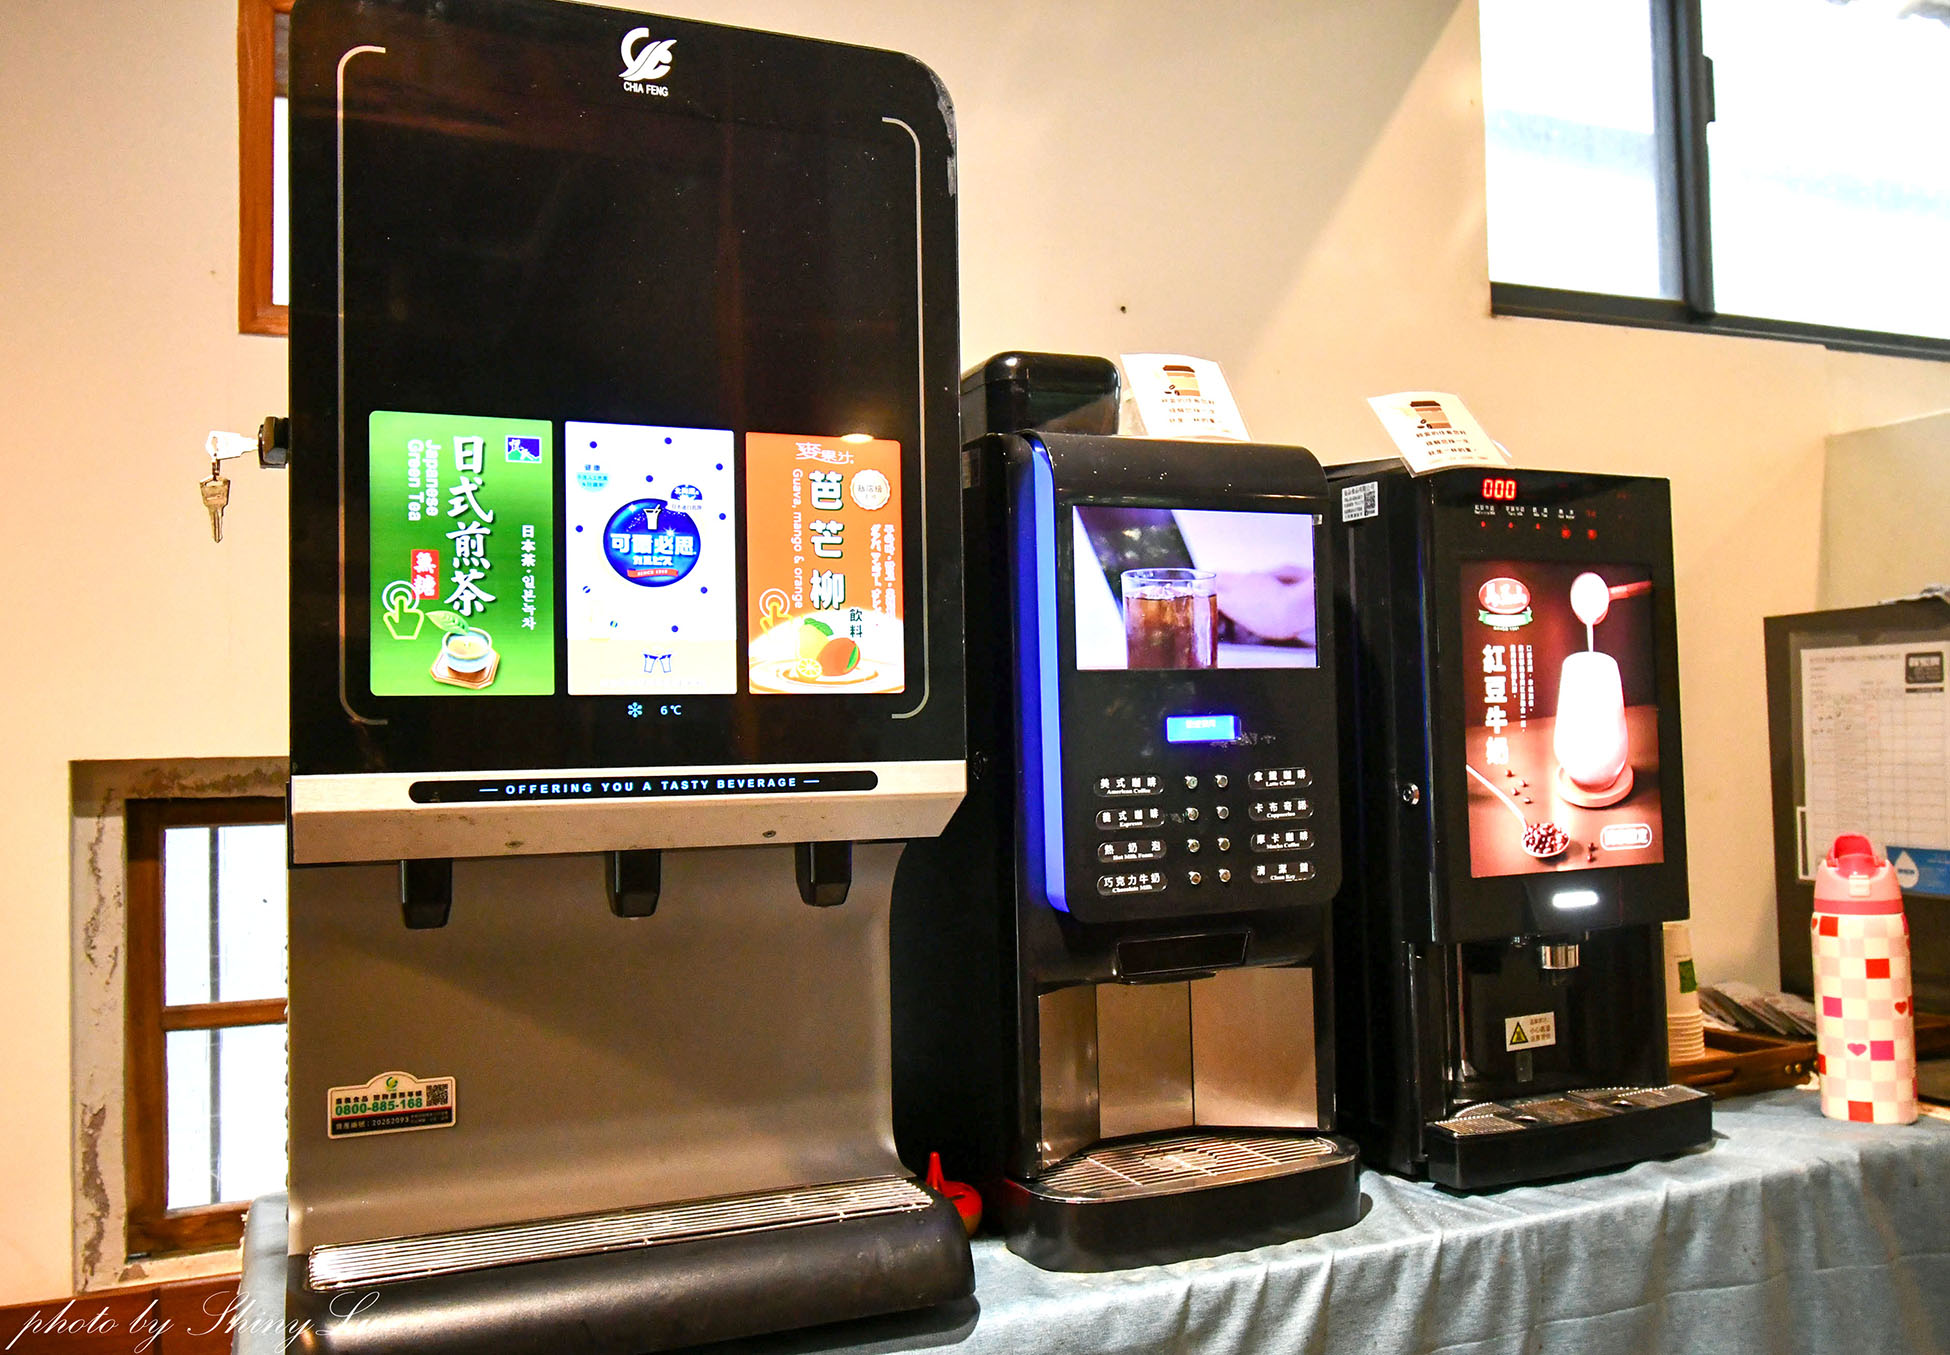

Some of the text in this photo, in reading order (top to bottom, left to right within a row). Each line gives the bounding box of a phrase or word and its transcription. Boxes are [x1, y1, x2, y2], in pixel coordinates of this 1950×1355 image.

[624, 81, 668, 97] CHIA FENG
[407, 439, 424, 521] Green Tea
[425, 439, 441, 517] Japanese
[792, 468, 804, 509] Guava,
[1483, 479, 1516, 499] 000
[444, 435, 496, 617] 日式煎茶
[791, 511, 803, 552] mango
[808, 470, 845, 610] 芭芒柳
[791, 564, 803, 609] orange
[849, 607, 863, 638] 飲料
[505, 777, 797, 795] OFFERING YOU A TASTY BEVERAGE
[1254, 799, 1307, 814] 卡布奇諾
[1103, 872, 1161, 888] 巧克力牛奶
[335, 1097, 423, 1116] 0800-885-168
